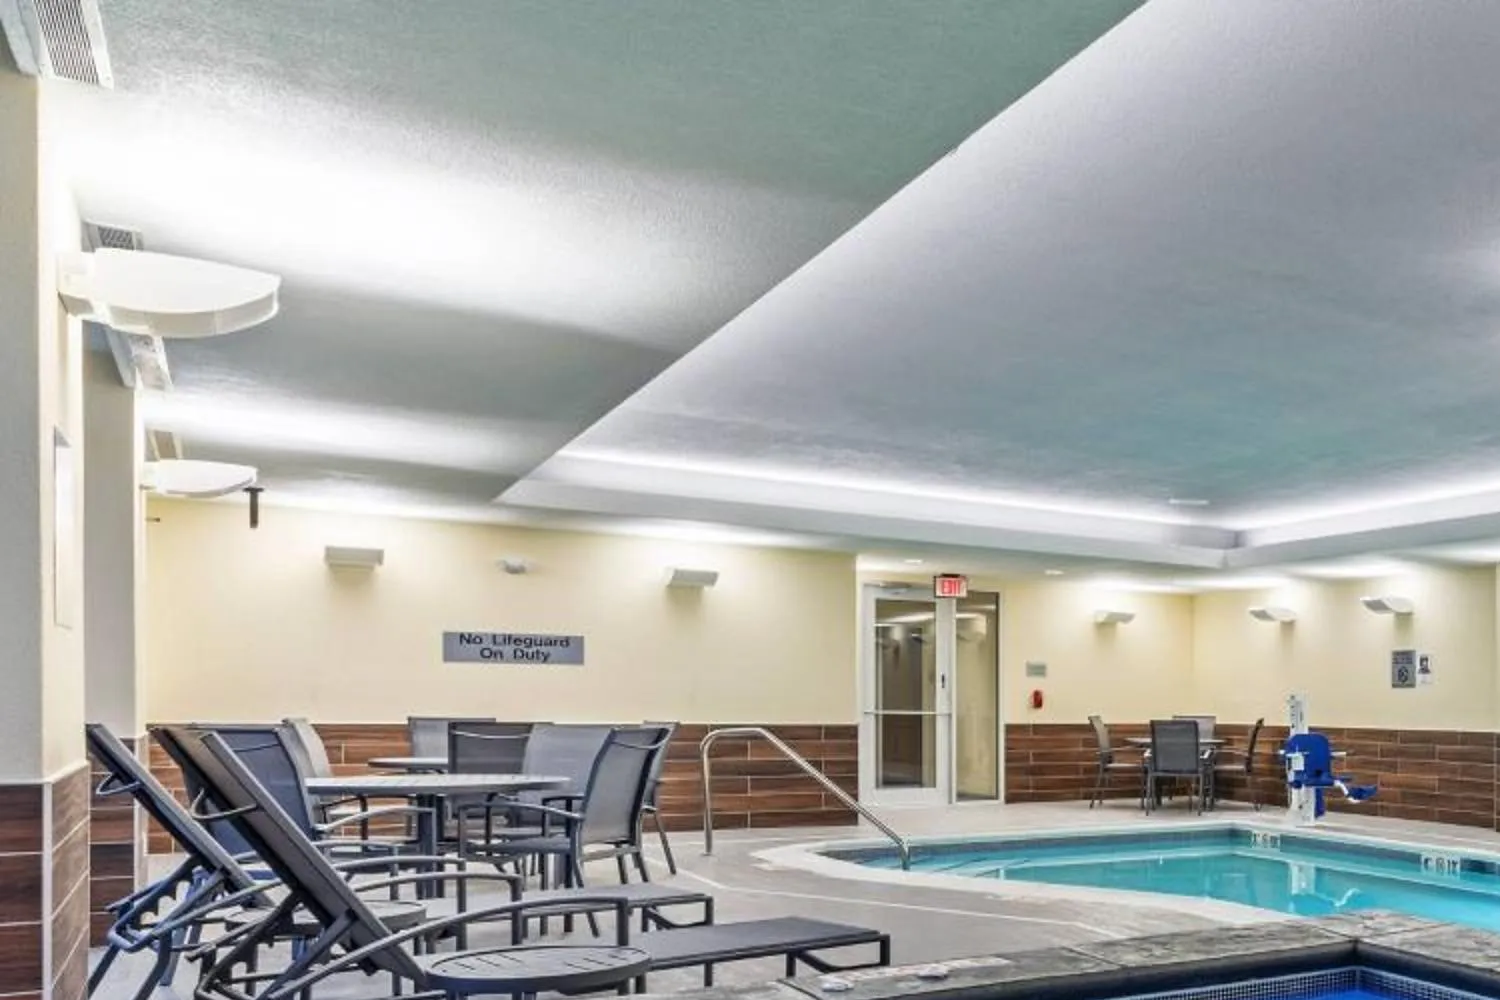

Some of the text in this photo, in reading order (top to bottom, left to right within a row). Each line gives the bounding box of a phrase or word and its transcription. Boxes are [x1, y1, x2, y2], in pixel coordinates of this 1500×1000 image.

[459, 633, 570, 648] No Lifeguard
[480, 648, 551, 663] On Duty
